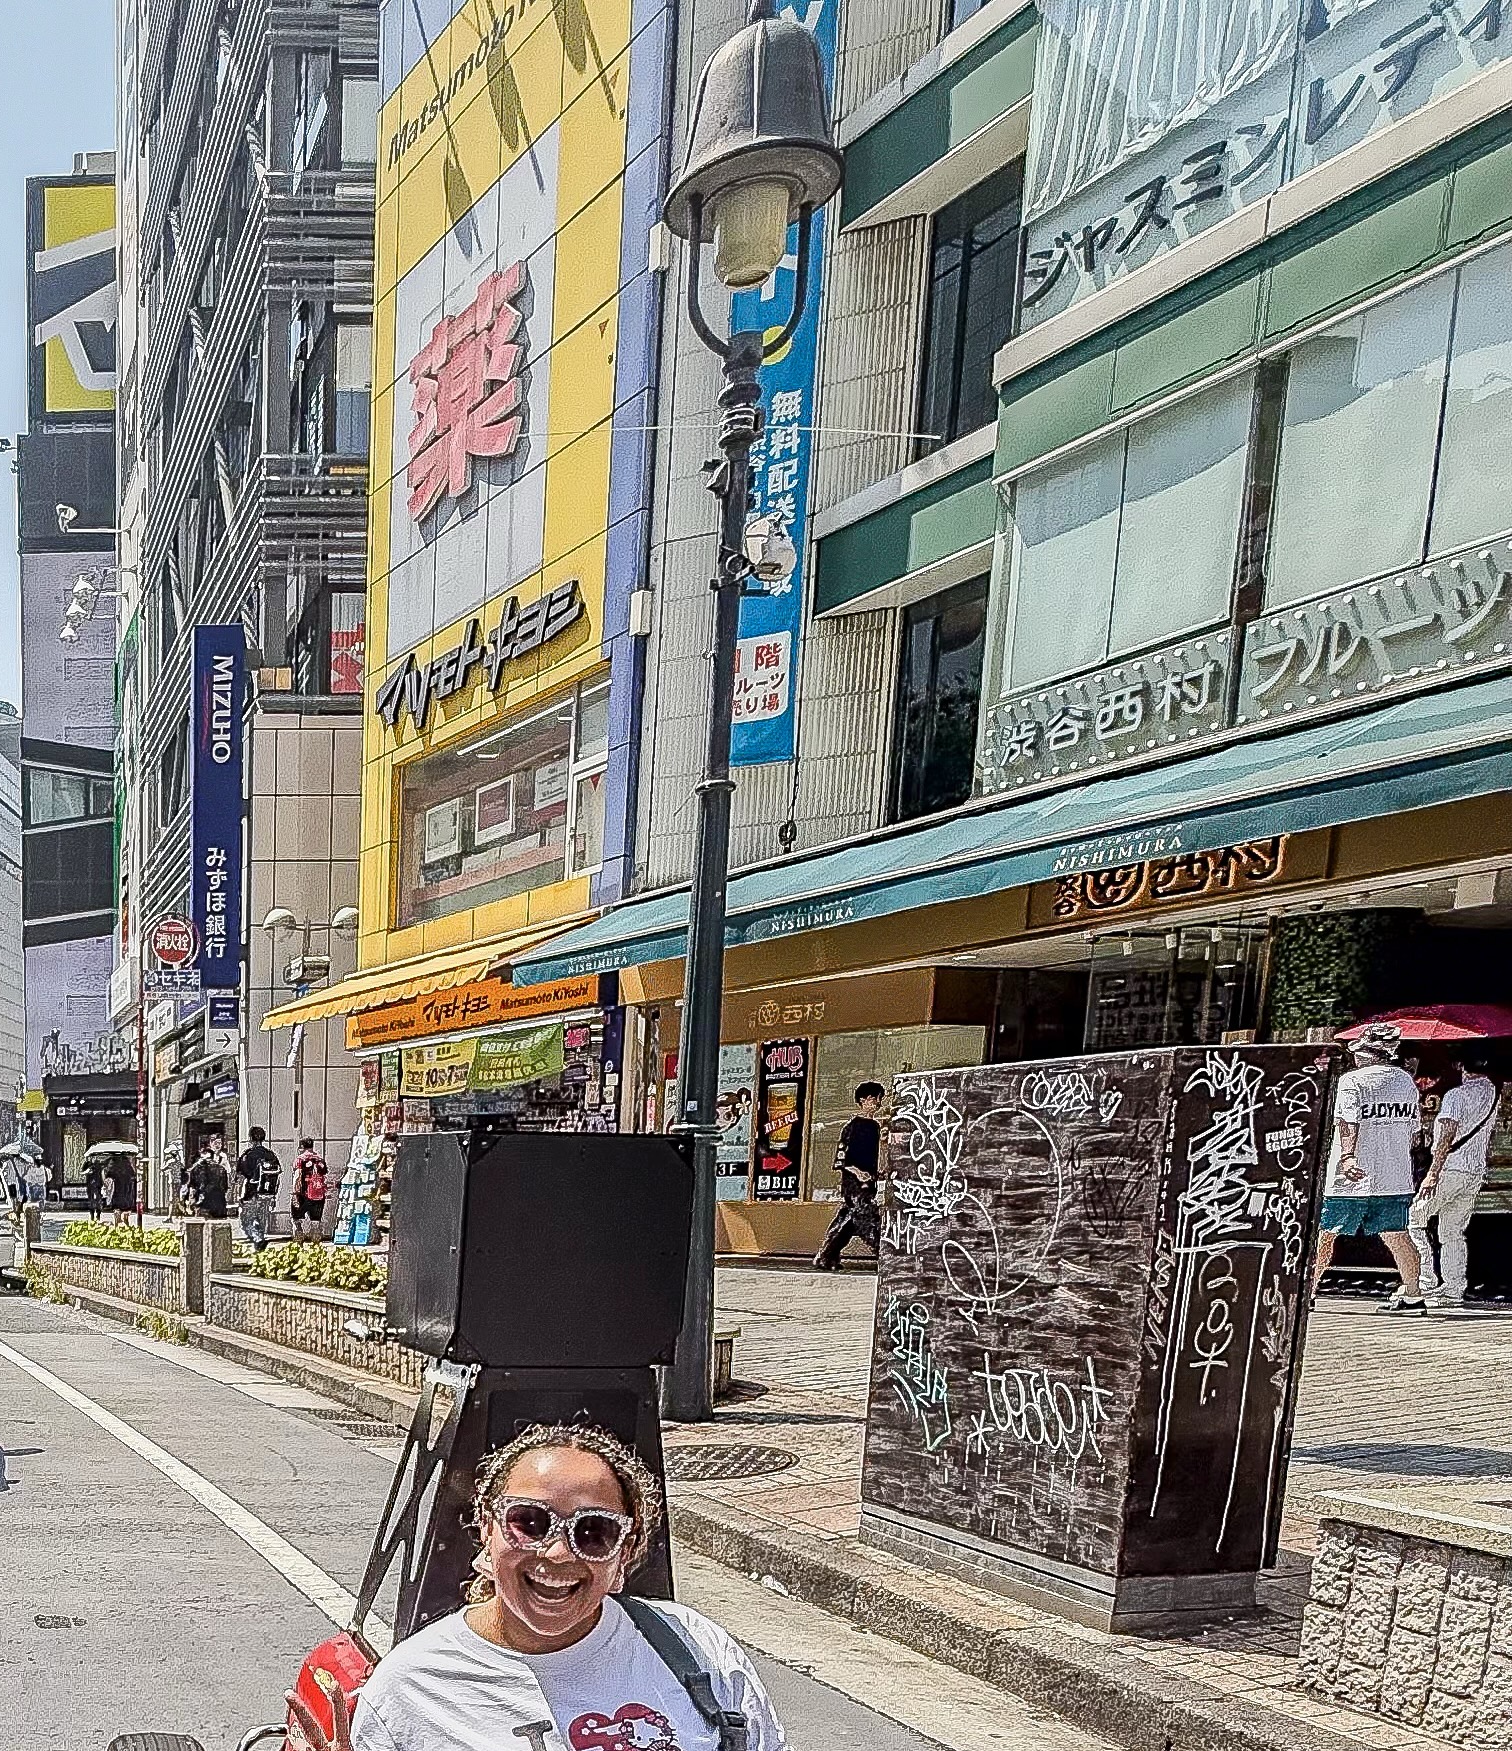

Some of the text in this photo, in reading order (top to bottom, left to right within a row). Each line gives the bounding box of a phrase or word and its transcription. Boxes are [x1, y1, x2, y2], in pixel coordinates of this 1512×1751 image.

[406, 260, 530, 522] 薬
[735, 671, 785, 695] ルーツ
[210, 655, 234, 764] MIZUHO
[999, 661, 1220, 768] 渋谷西村
[1053, 836, 1183, 871] NISHIMURA
[204, 847, 228, 959] みずほ銀行
[771, 906, 855, 933] NISHIMURA
[156, 932, 190, 951] 消火栓
[500, 994, 552, 1011] Matsumoto
[765, 1045, 804, 1073] HUB
